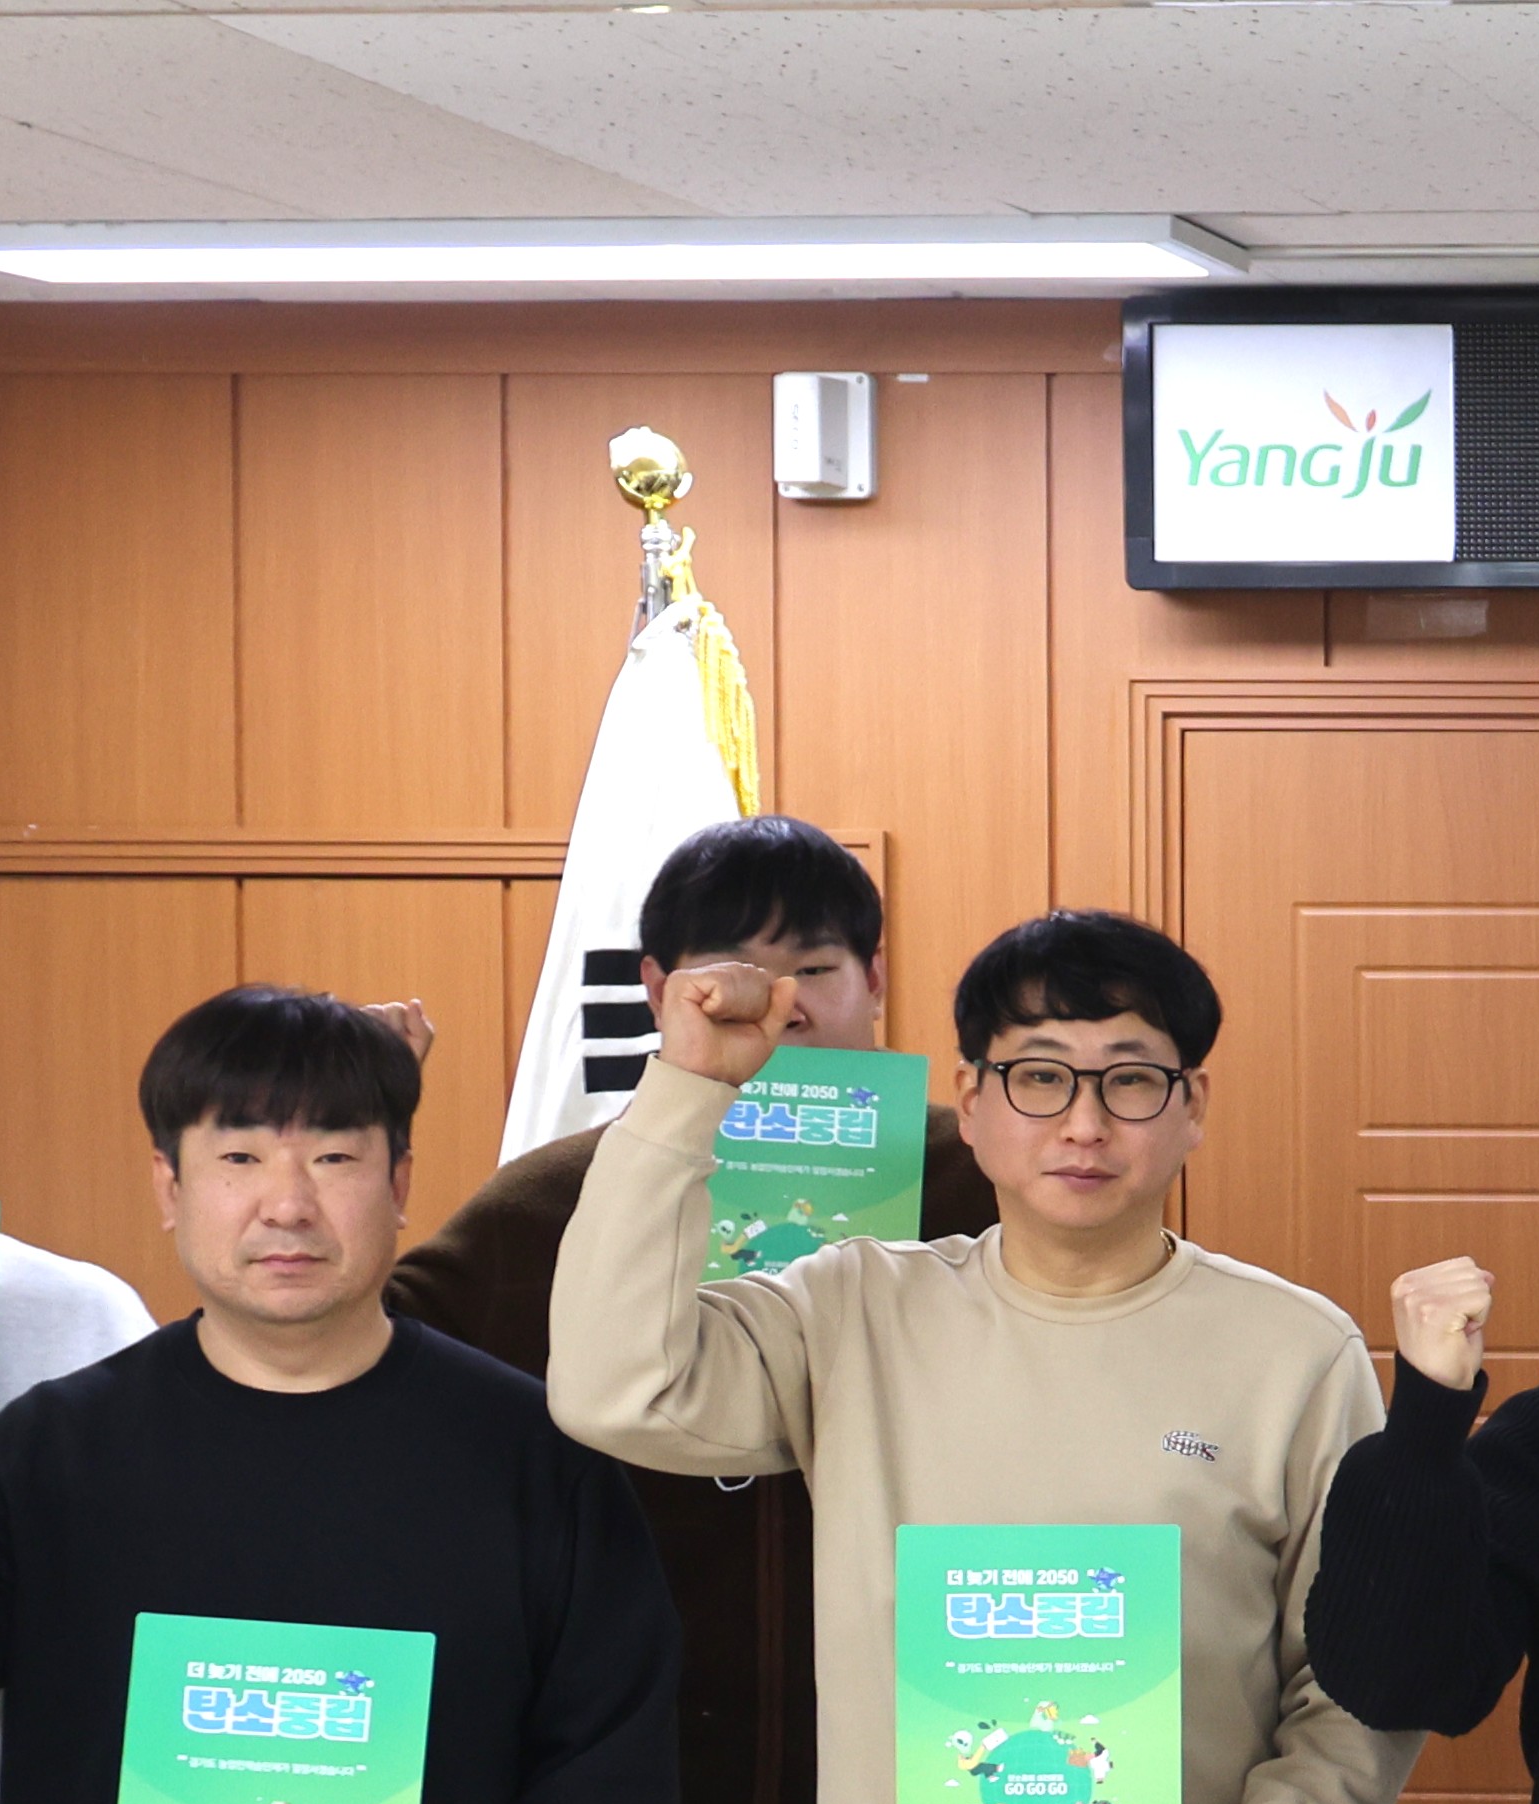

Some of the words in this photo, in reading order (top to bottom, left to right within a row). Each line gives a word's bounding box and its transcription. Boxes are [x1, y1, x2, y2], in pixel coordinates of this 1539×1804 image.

[800, 1084, 839, 1100] 2050
[719, 1099, 877, 1148] 탄소중립
[946, 1569, 963, 1585] 더
[966, 1569, 998, 1585] 늦기
[1001, 1568, 1033, 1585] 전에
[1036, 1568, 1078, 1585] 2050
[945, 1591, 1124, 1639] 탄소중립
[186, 1661, 204, 1678] 더
[281, 1667, 326, 1686] 2050
[182, 1685, 371, 1742] 탄소중립
[1004, 1781, 1025, 1795] GO
[1025, 1781, 1046, 1795] GO
[1047, 1781, 1067, 1795] GO
